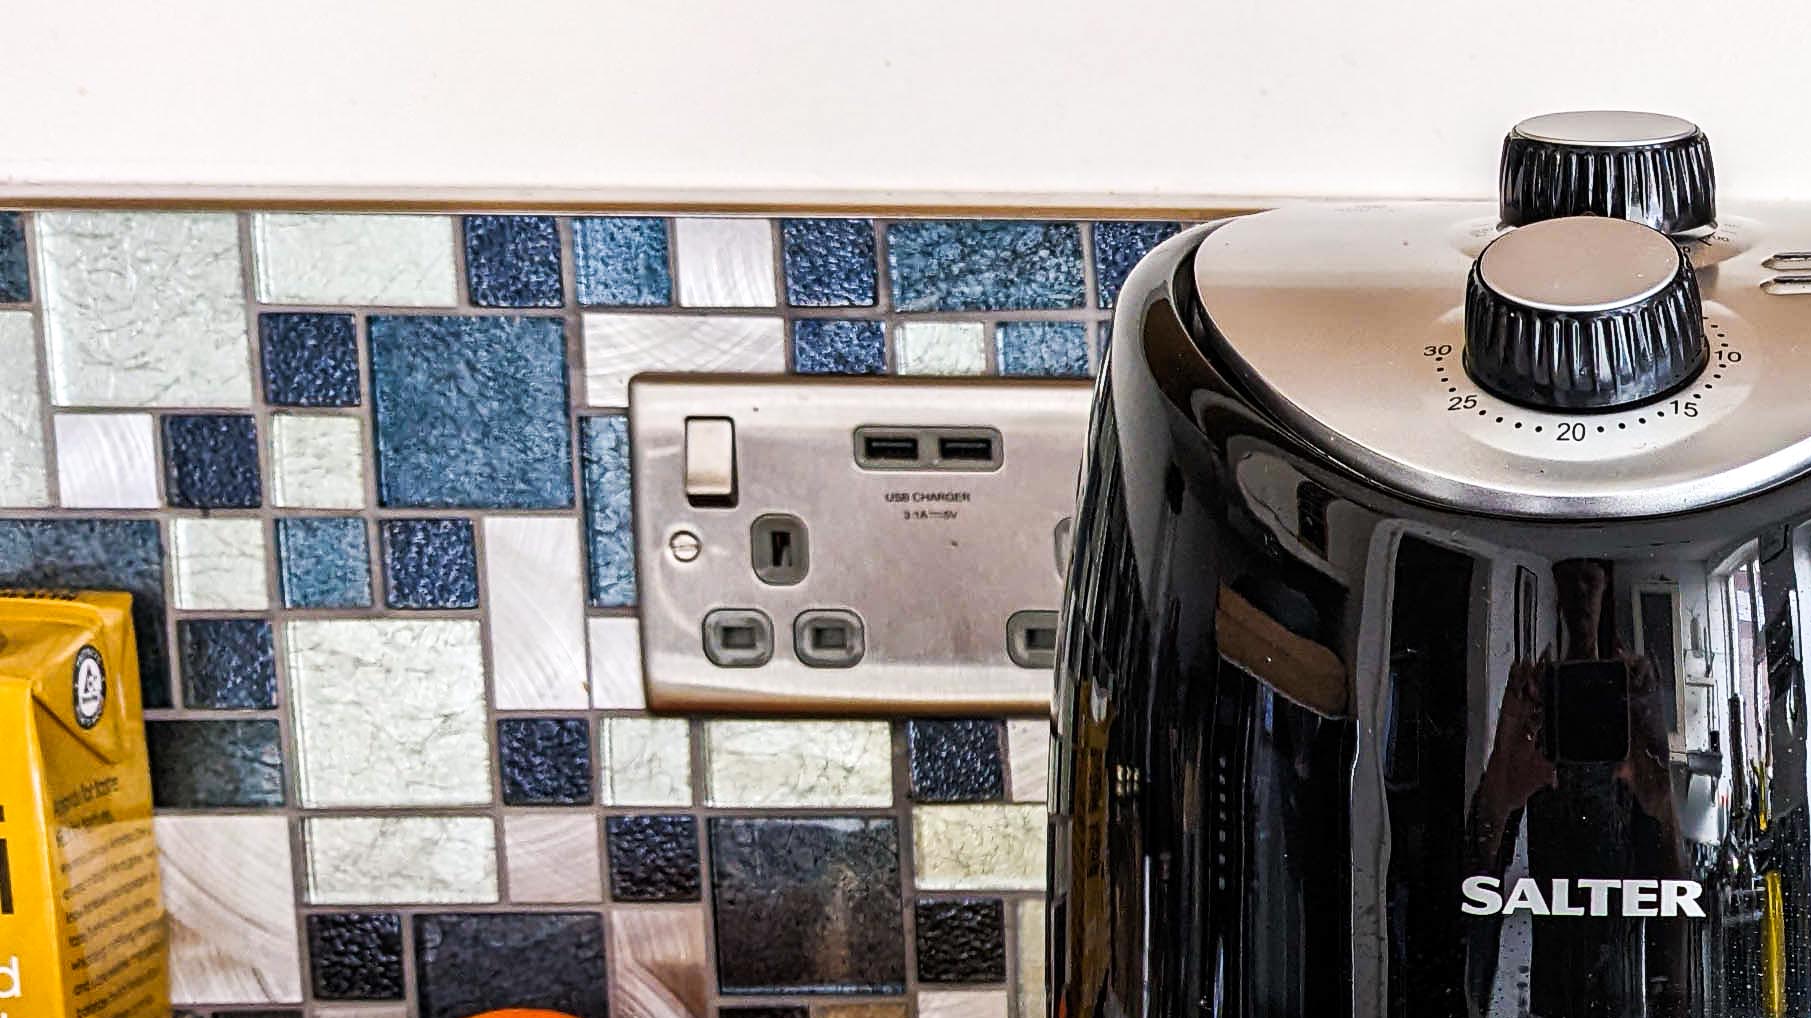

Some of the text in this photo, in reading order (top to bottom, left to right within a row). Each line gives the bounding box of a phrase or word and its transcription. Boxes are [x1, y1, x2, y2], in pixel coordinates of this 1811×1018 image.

[1423, 344, 1453, 357] 30
[1714, 350, 1742, 363] 10
[1447, 394, 1478, 411] 25
[1669, 400, 1699, 418] 15
[1556, 422, 1586, 441] 20
[885, 492, 970, 503] USB CHARGER
[1461, 875, 1706, 918] SALTER
